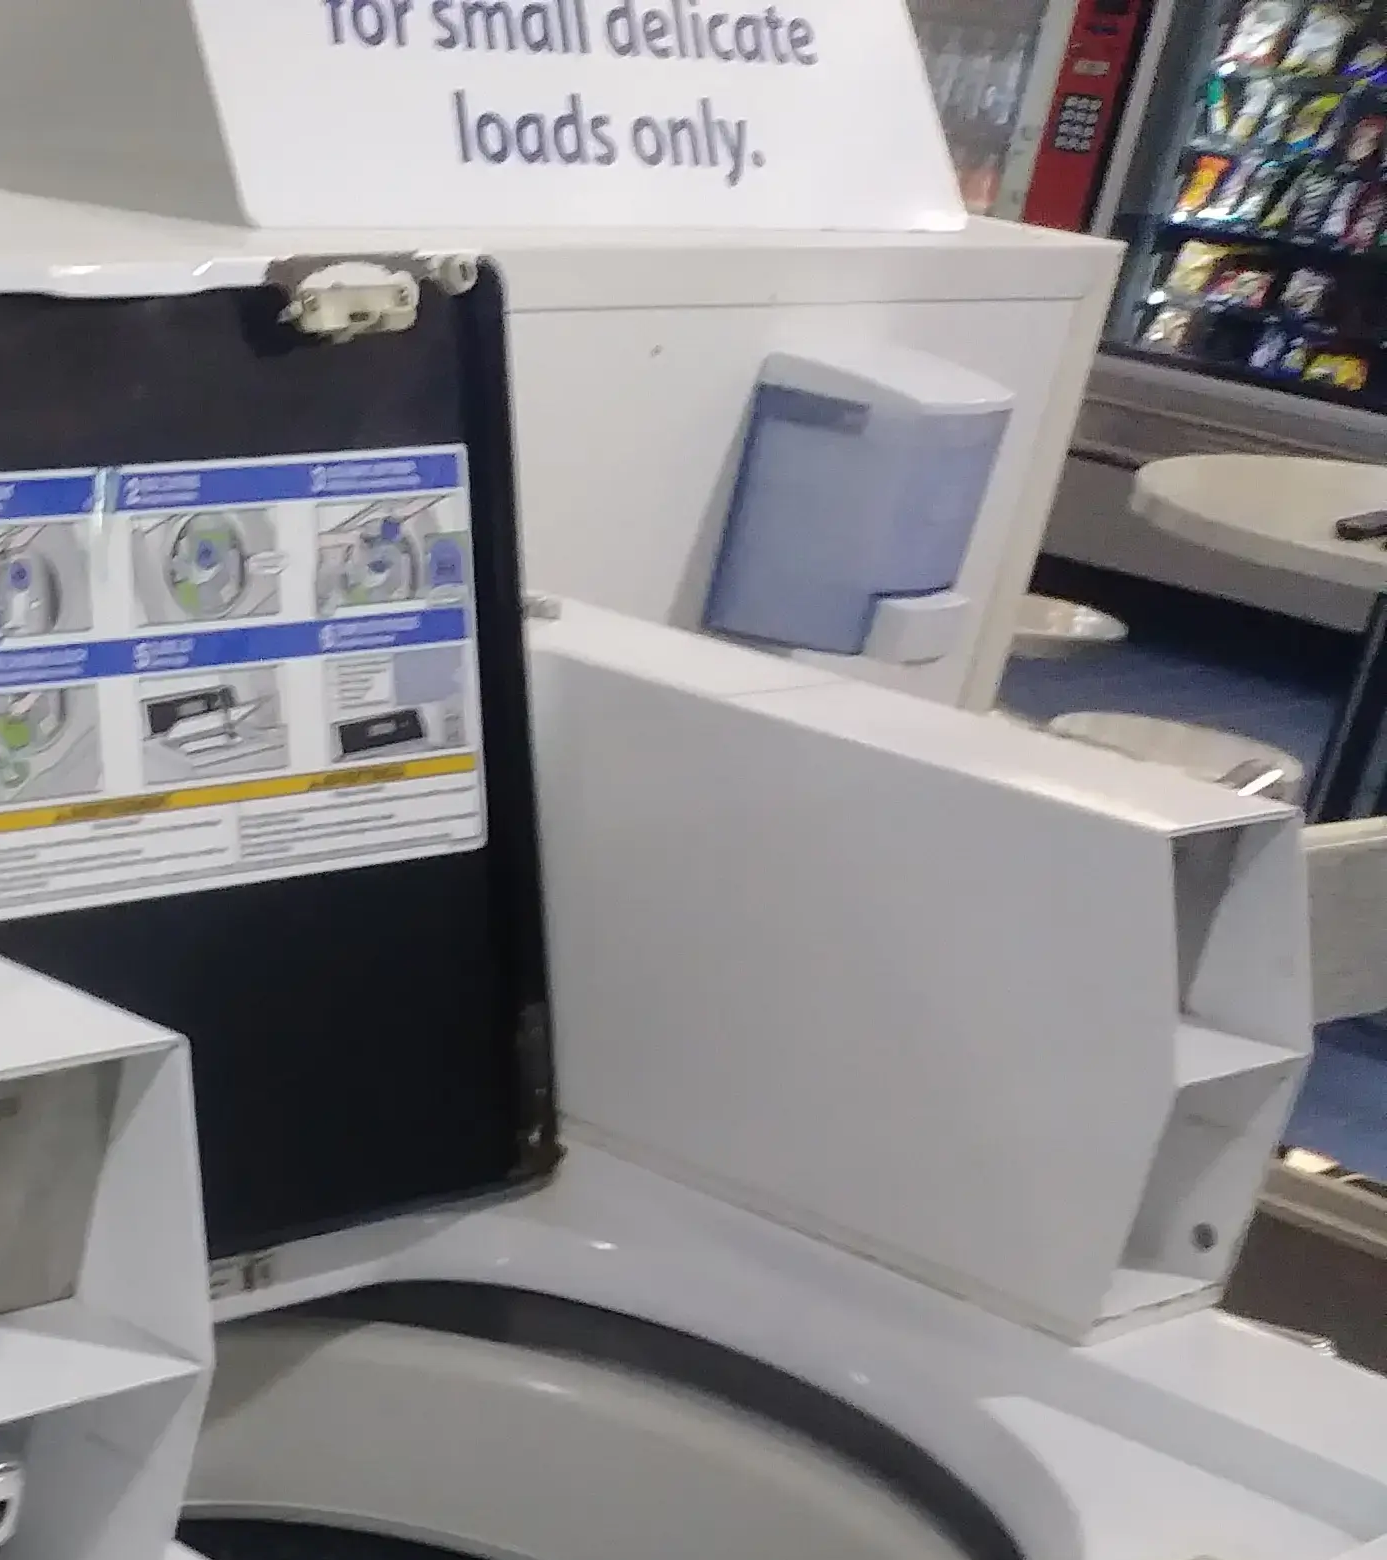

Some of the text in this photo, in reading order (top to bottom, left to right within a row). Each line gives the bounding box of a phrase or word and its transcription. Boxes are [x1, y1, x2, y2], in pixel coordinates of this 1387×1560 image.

[325, 0, 819, 66] for small delicate
[453, 88, 767, 187] loads only.
